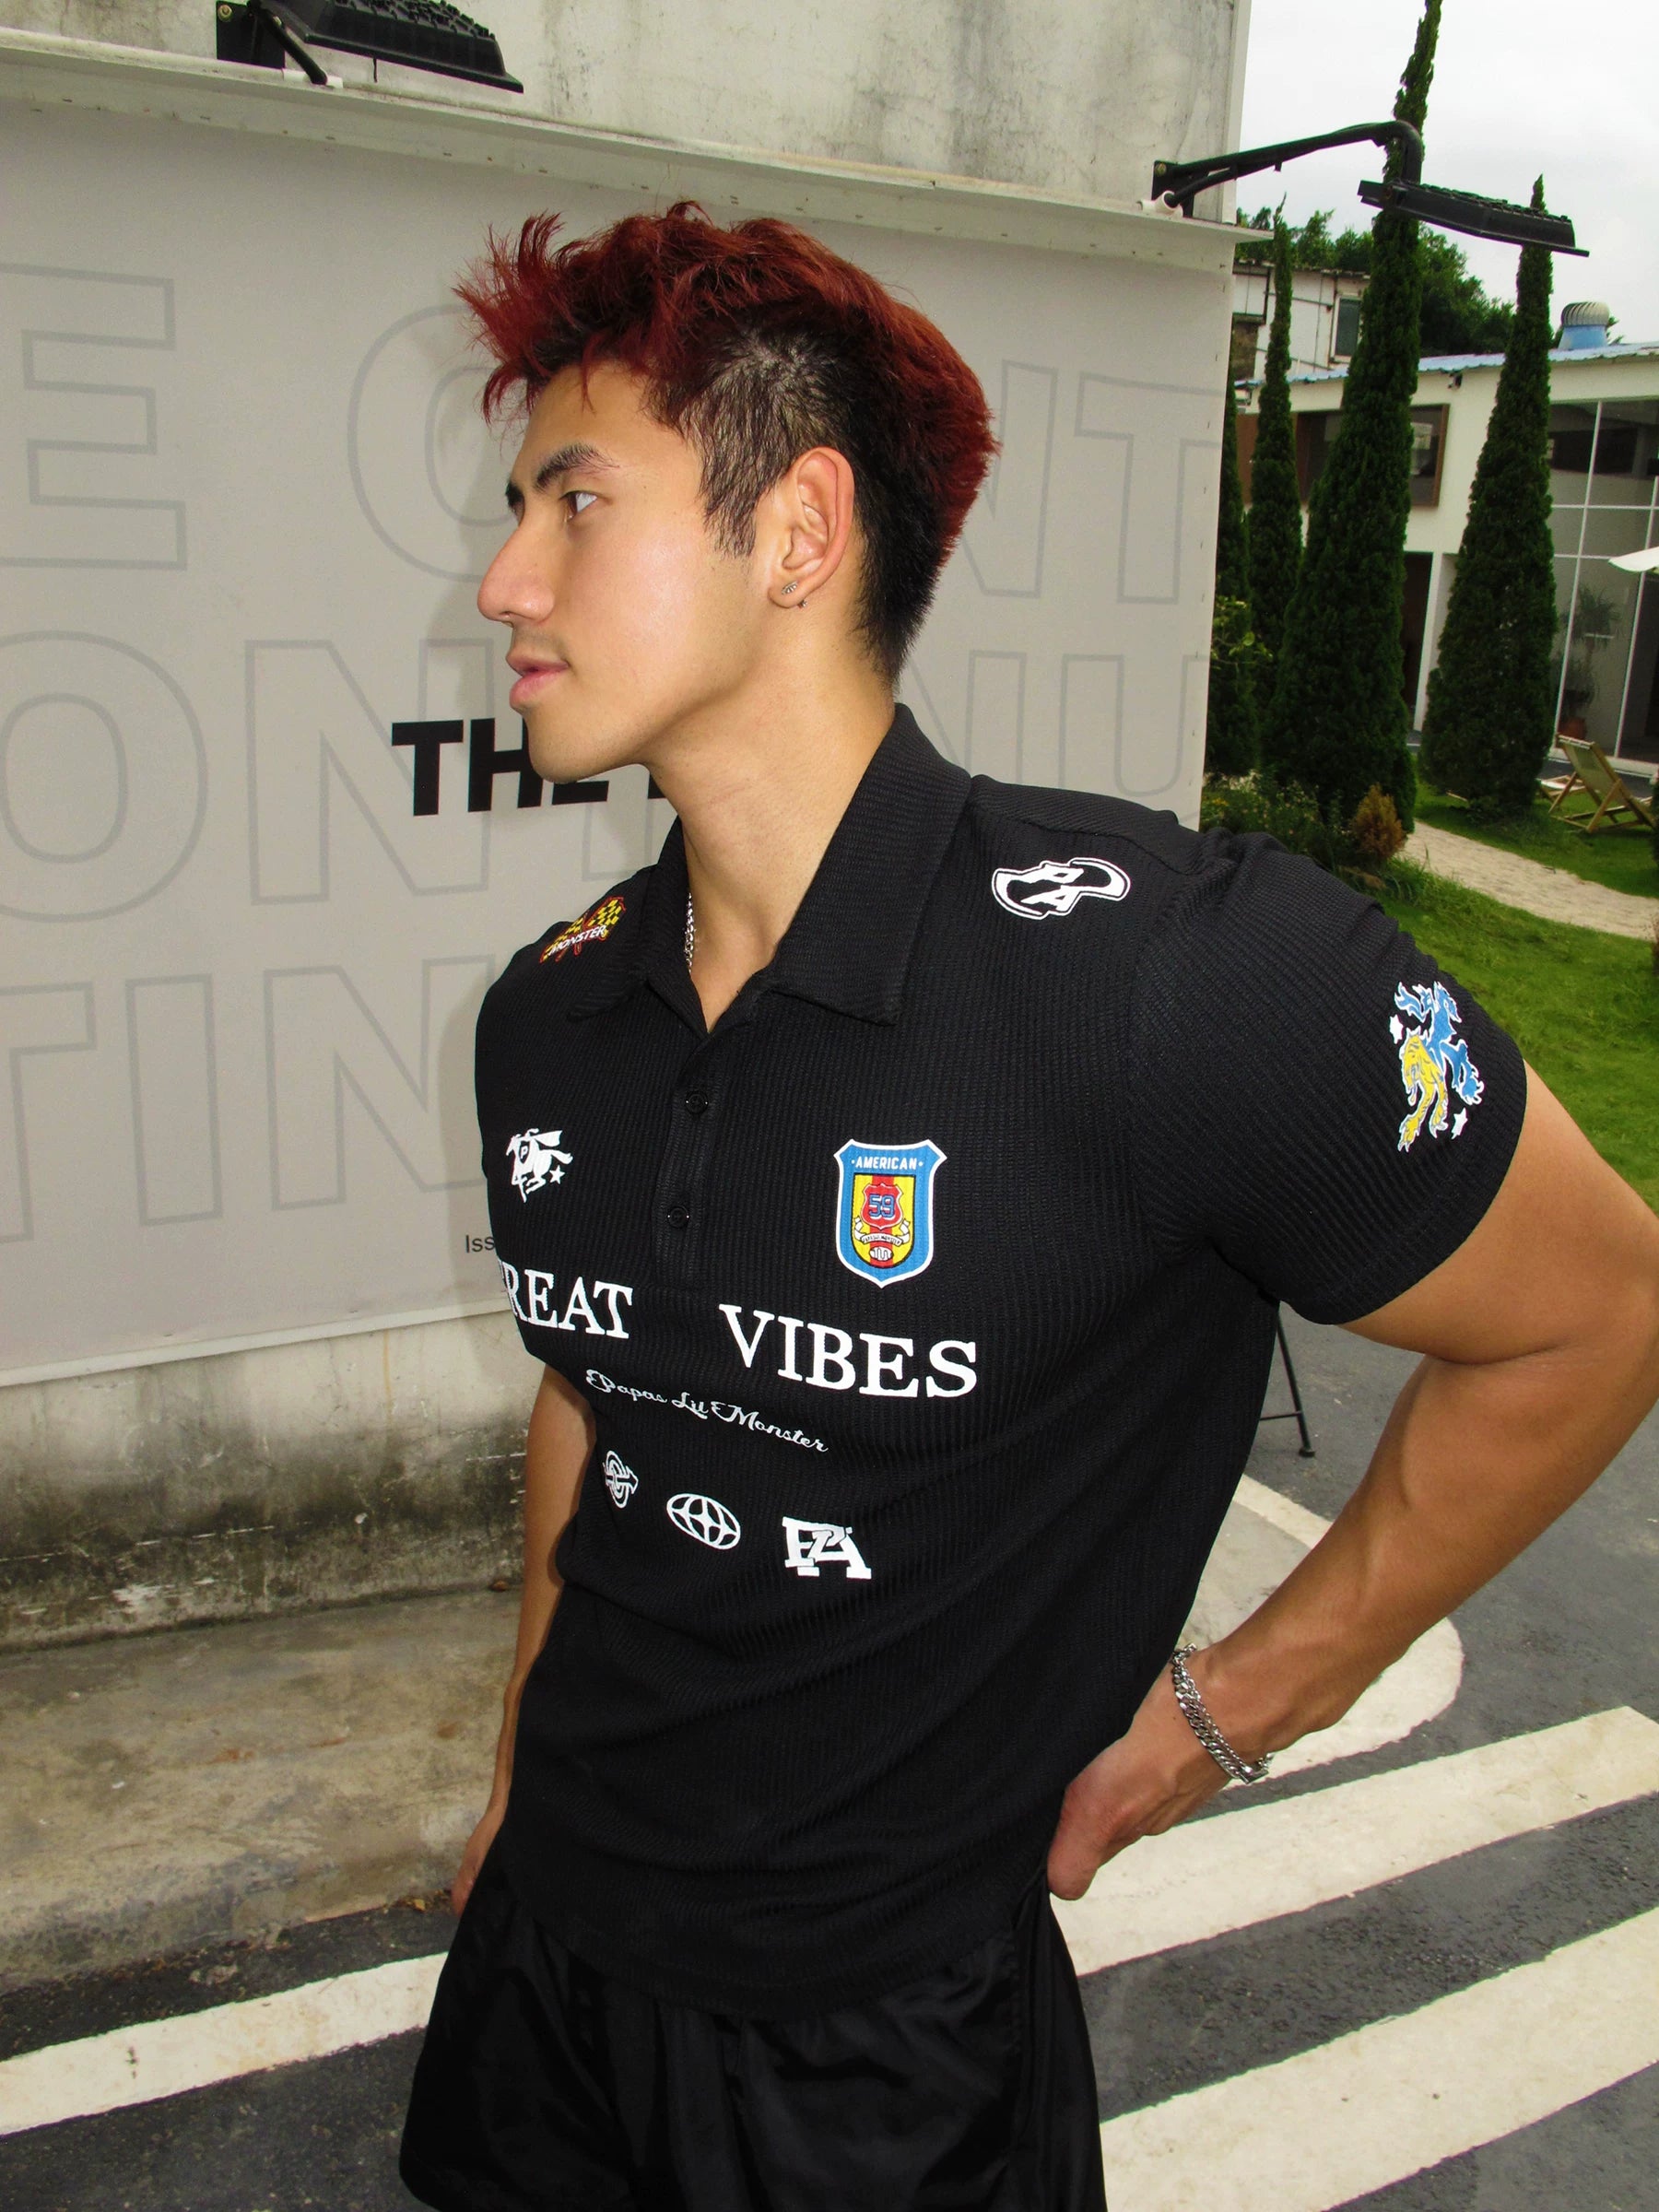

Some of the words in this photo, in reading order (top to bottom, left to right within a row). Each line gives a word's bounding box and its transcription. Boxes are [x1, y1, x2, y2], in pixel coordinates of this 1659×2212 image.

[547, 924, 606, 957] MONSTER
[855, 1156, 918, 1171] AMERICAN
[868, 1193, 896, 1220] 59
[499, 1257, 634, 1339] REAT
[718, 1302, 978, 1399] VIBES
[585, 1368, 668, 1402] Papas
[711, 1400, 829, 1453] Monster
